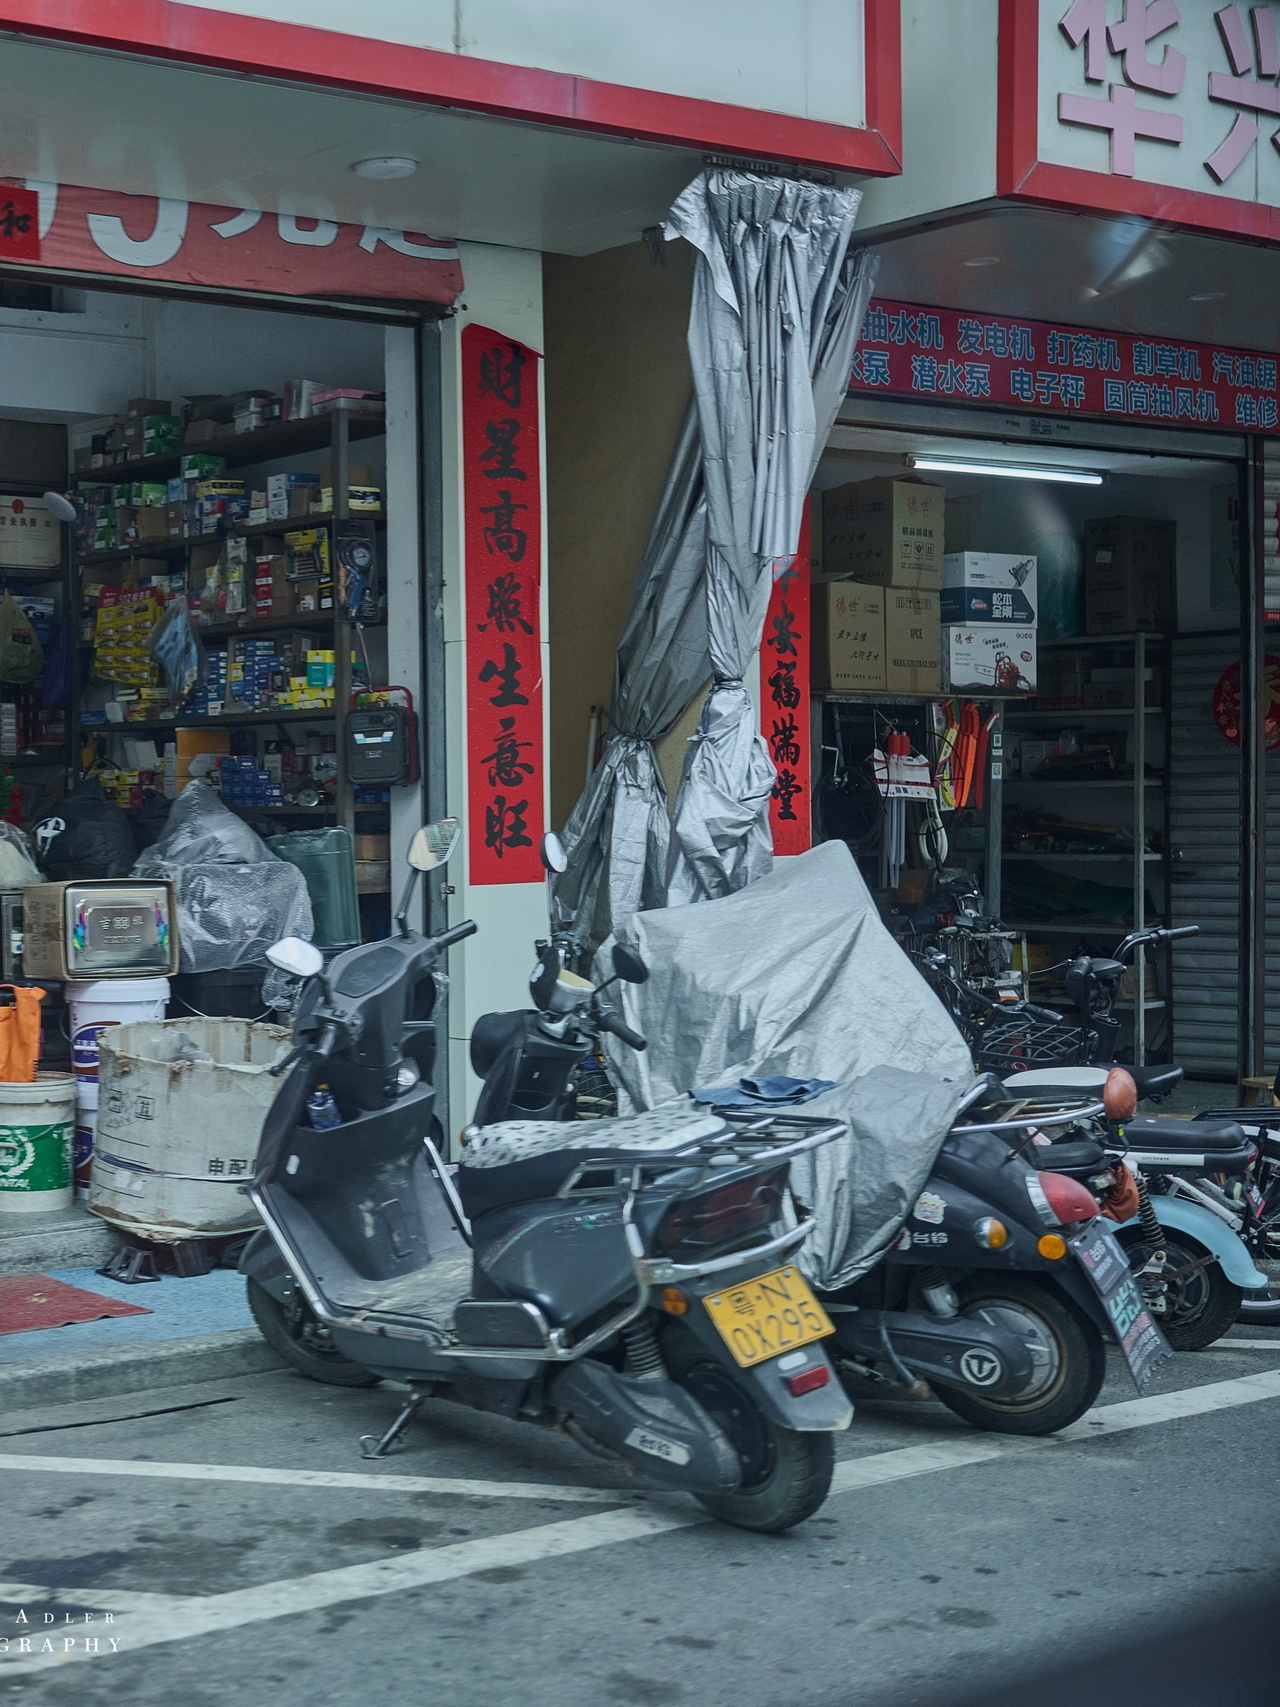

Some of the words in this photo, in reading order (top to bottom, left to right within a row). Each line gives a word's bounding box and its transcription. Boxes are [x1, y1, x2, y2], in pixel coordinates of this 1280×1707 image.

[957, 319, 1035, 362] 发电机
[1046, 330, 1122, 372] 打药机
[1132, 340, 1202, 382] 割草机
[1212, 350, 1279, 391] 汽油锯
[911, 354, 992, 398] 潜水泵
[1010, 368, 1086, 408] 电子秤
[1103, 378, 1220, 423] 圆筒抽风机
[1233, 393, 1280, 429] 维修
[209, 1157, 258, 1176] 申配
